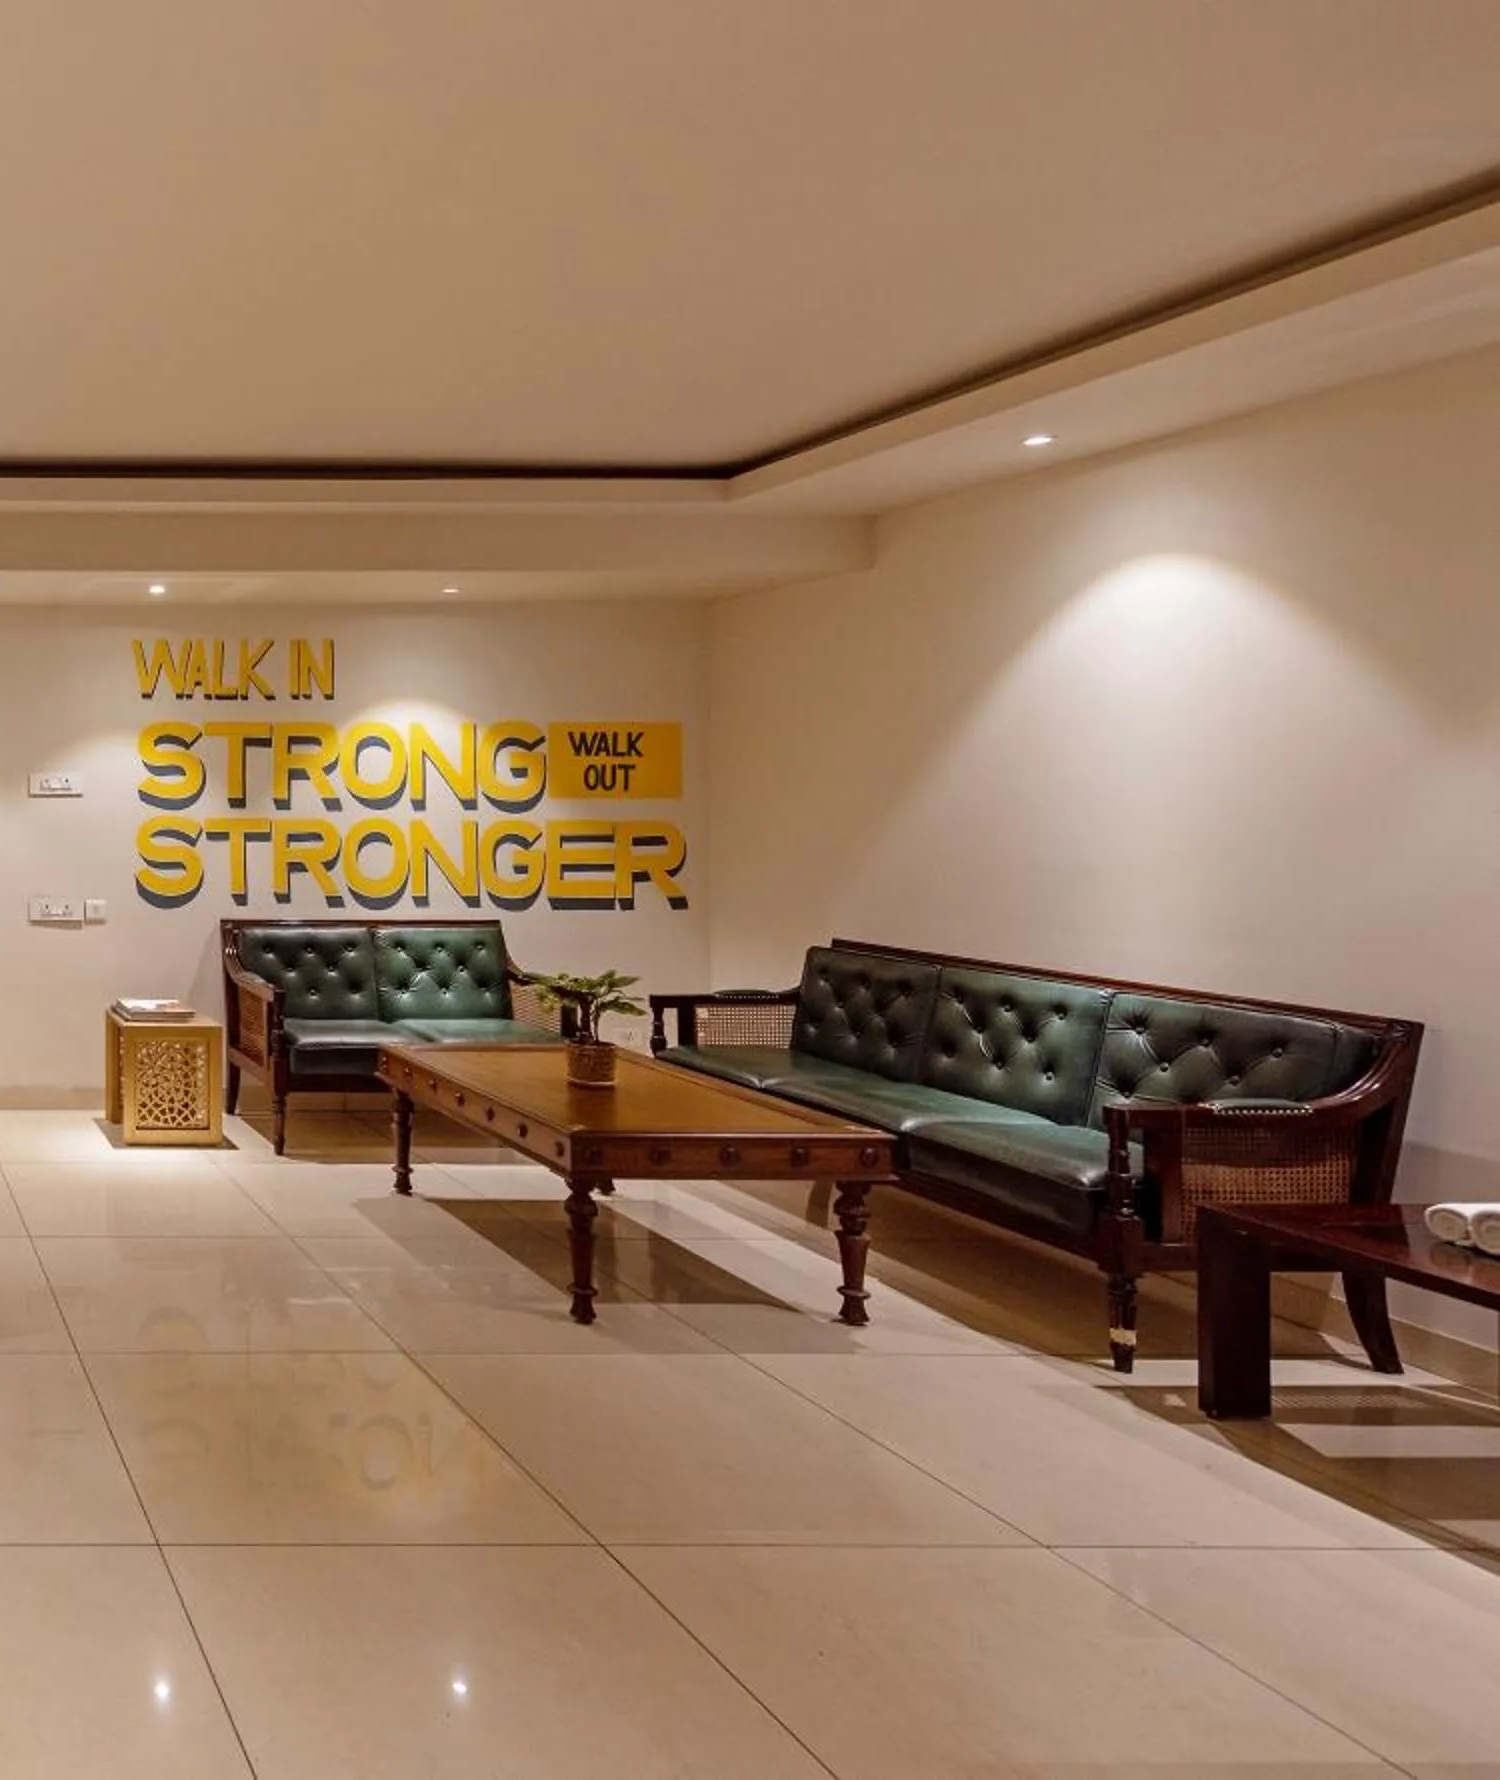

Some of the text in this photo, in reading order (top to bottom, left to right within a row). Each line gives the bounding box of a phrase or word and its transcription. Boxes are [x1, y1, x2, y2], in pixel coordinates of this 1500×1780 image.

[131, 638, 336, 701] WALK IN
[136, 720, 547, 814] STRONG
[568, 731, 643, 757] WALK
[584, 763, 637, 792] OUT
[134, 817, 690, 910] STRONGER
